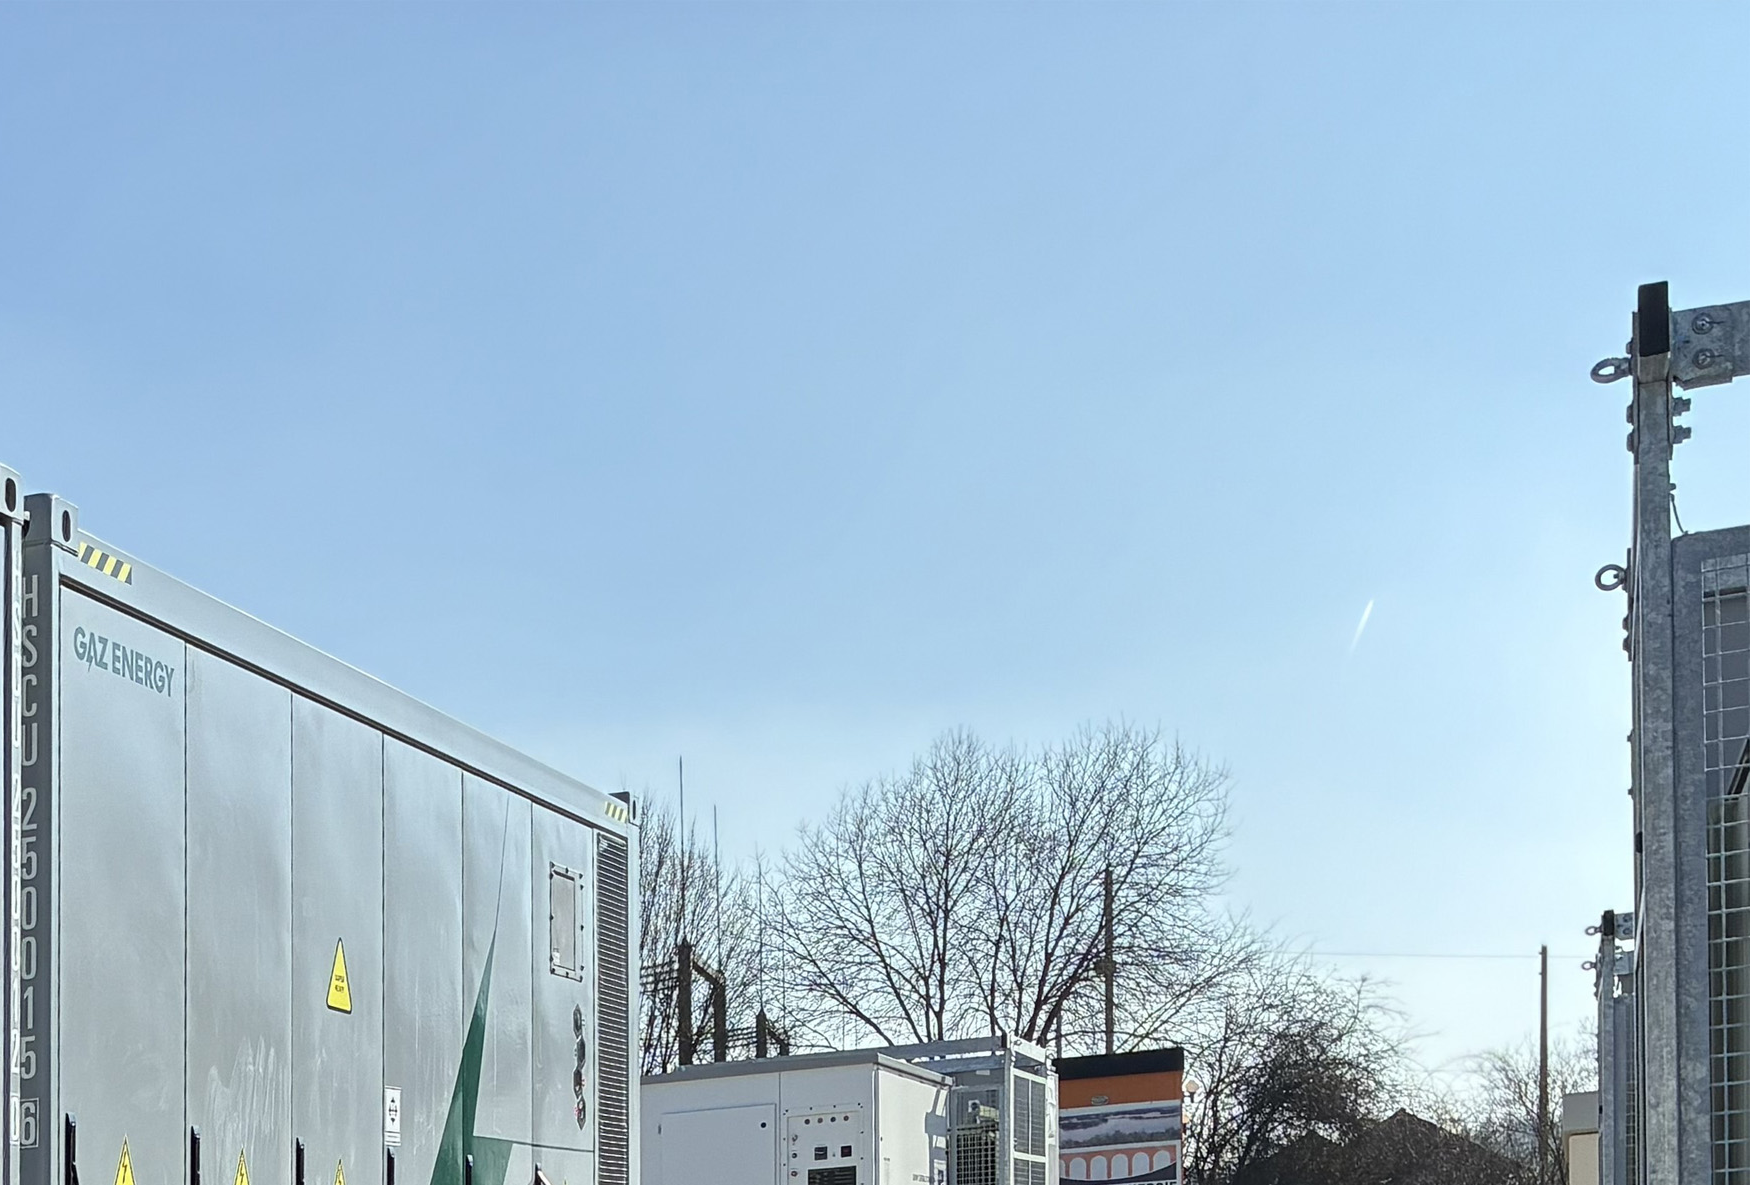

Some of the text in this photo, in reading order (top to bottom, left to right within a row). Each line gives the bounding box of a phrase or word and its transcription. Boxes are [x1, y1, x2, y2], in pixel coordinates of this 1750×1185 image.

[21, 574, 39, 767] HSCU
[73, 626, 175, 698] GAZ ENERGY
[20, 787, 38, 1080] 250015
[20, 1102, 35, 1145] 6
